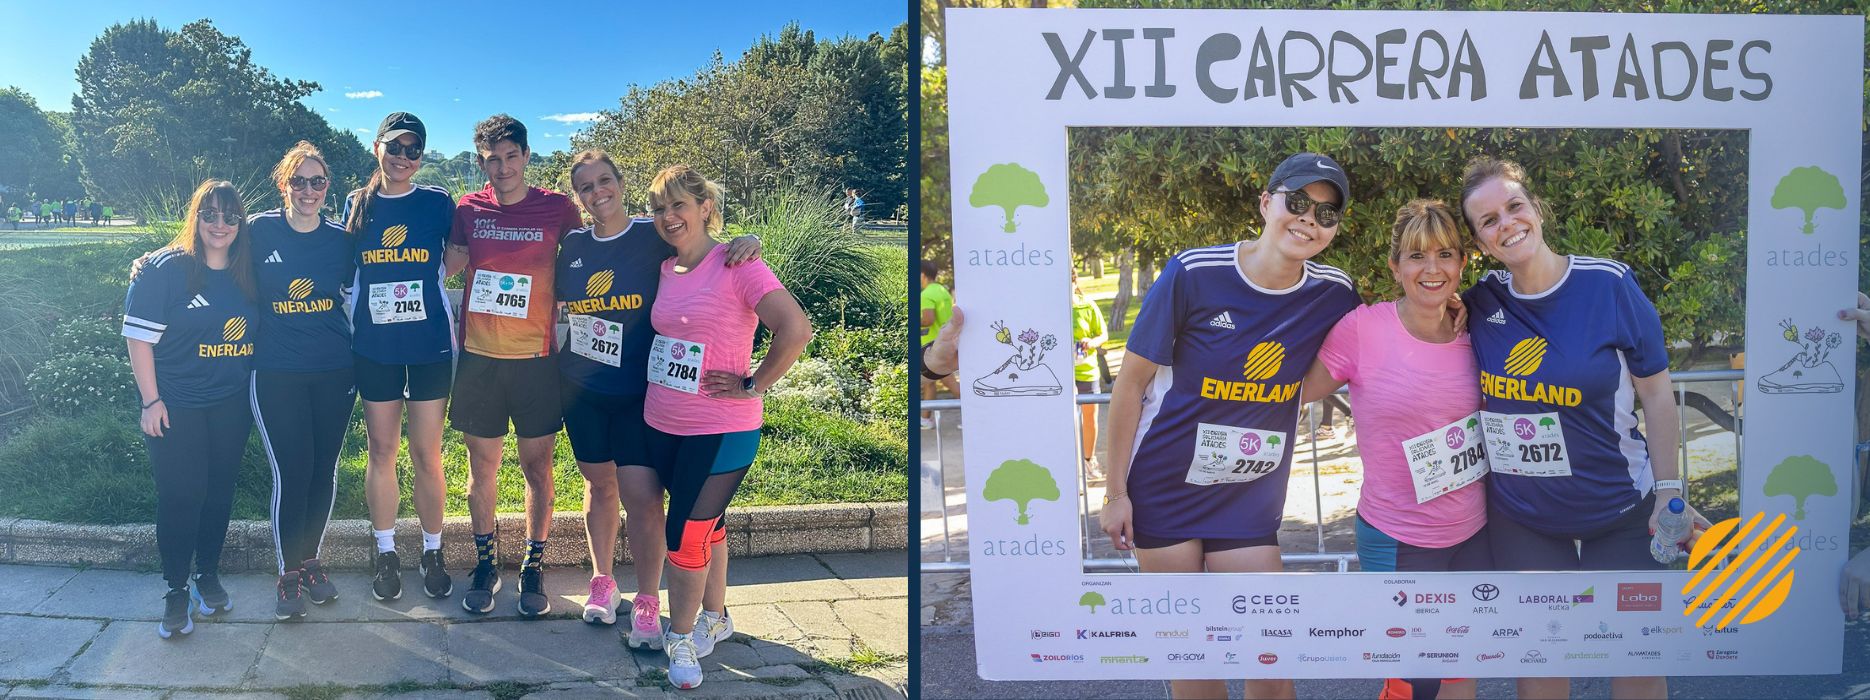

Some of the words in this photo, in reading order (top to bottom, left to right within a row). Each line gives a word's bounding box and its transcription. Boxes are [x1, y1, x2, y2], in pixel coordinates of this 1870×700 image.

[1041, 28, 1177, 100] XII
[1195, 26, 1487, 108] CARRERA
[1519, 29, 1773, 101] ATADES
[362, 248, 430, 265] ENERLAND
[968, 243, 1054, 267] atades
[1767, 243, 1848, 267] atades
[394, 287, 407, 296] 5K
[272, 299, 334, 314] ENERLAND
[395, 300, 422, 313] 2742
[496, 293, 526, 308] 4765
[568, 294, 643, 314] ENERLAND
[593, 323, 605, 334] 5K
[1210, 320, 1235, 330] adidas
[591, 337, 619, 356] 2672
[672, 345, 685, 357] 5K
[667, 361, 698, 382] 2784
[1481, 370, 1583, 407] ENERLAND
[1515, 423, 1535, 436] 5K
[1240, 438, 1260, 451] 5K
[1447, 429, 1464, 447] 5K
[1450, 442, 1486, 475] 2784
[1519, 443, 1564, 463] 2672
[1231, 459, 1276, 474] 2742
[984, 533, 1066, 557] atades
[1111, 590, 1201, 615] atades
[1251, 595, 1300, 605] CEOE
[1415, 593, 1456, 604] DEXIS
[1519, 595, 1570, 604] LABORAL
[1251, 607, 1300, 615] ARAGÓN
[1472, 606, 1499, 614] ARTAL
[1583, 631, 1623, 641] podoactiva
